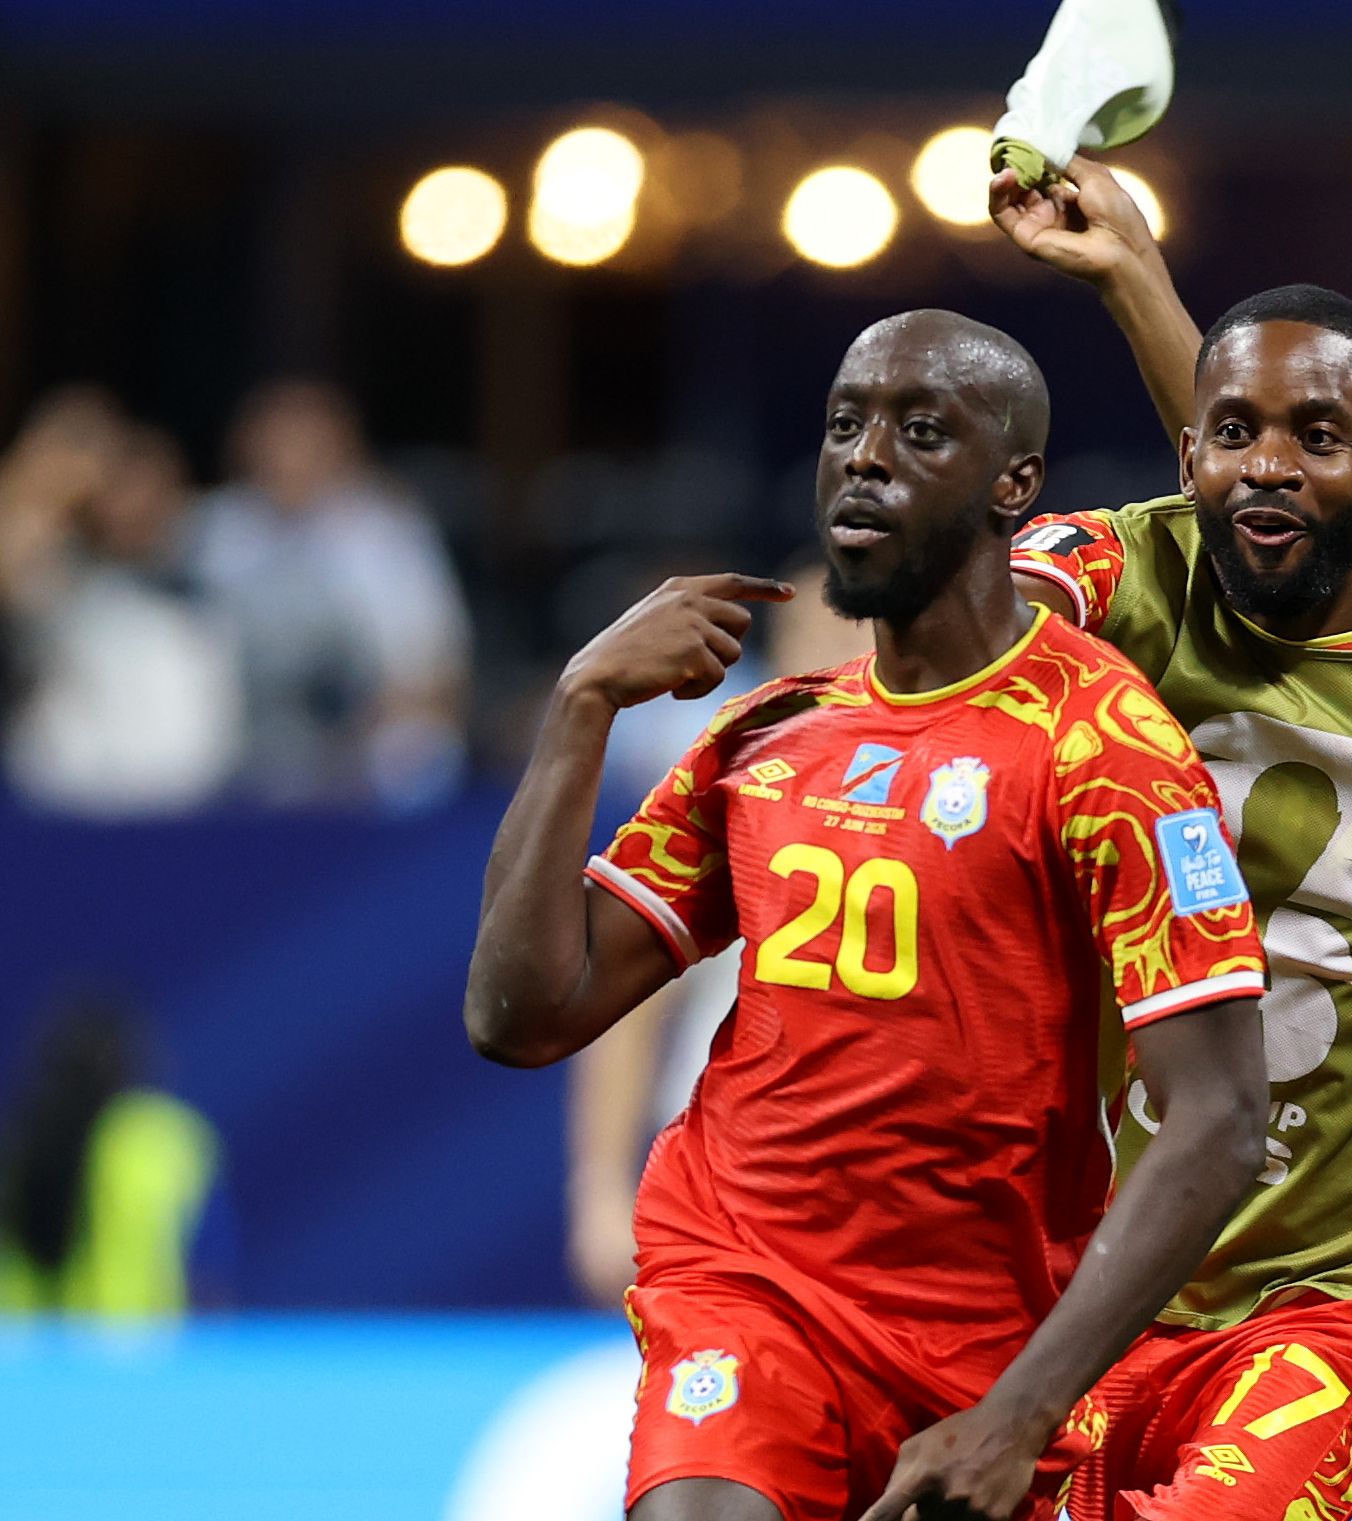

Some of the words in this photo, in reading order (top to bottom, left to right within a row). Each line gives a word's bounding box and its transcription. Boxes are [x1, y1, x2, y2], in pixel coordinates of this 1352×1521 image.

[823, 815, 840, 827] 27
[1185, 866, 1225, 891] PEACE
[754, 842, 919, 1000] 20
[1210, 1341, 1352, 1441] 17
